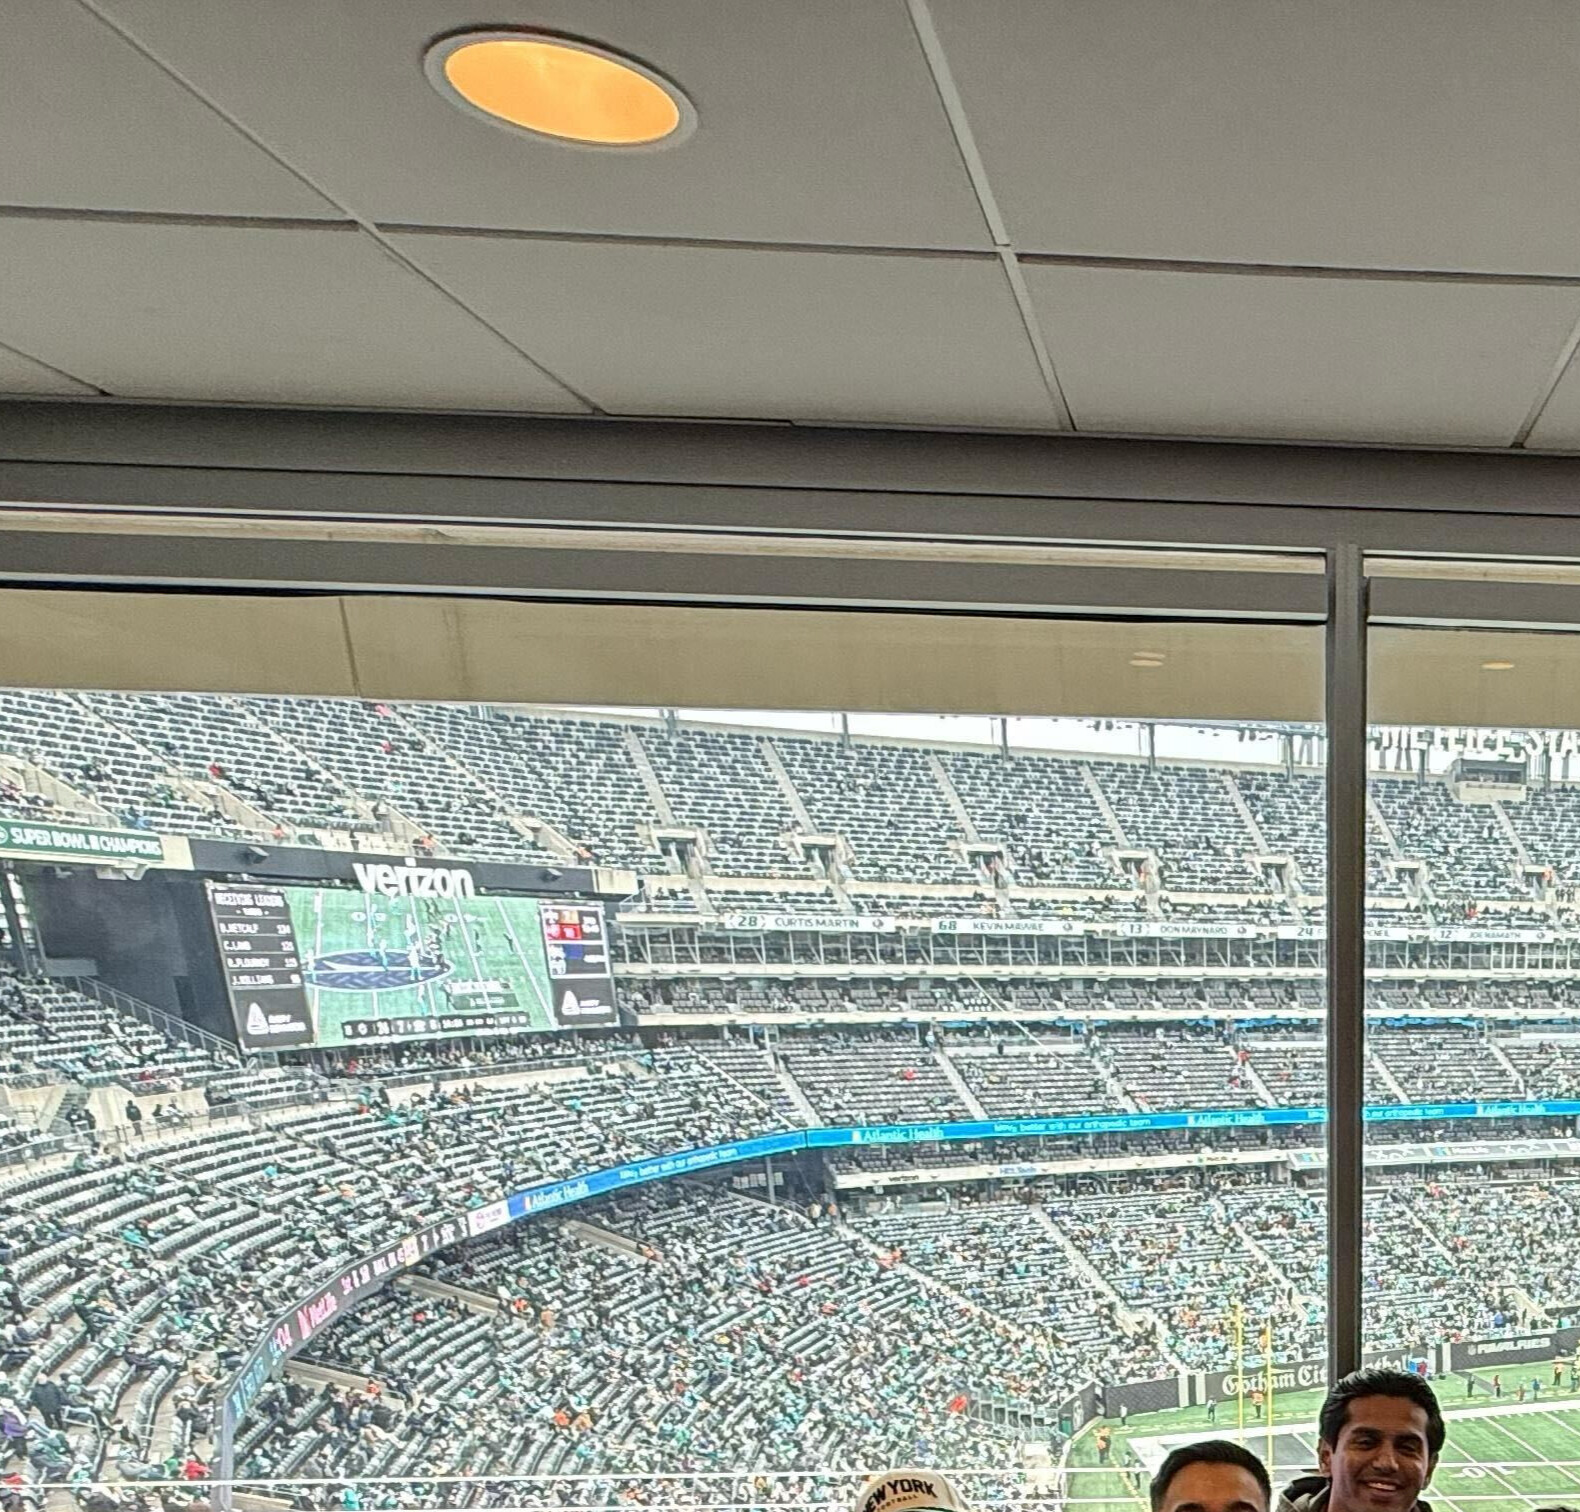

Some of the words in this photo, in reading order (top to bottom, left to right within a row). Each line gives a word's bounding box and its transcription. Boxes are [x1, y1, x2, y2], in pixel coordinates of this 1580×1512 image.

[11, 827, 51, 847] SUPER
[53, 831, 88, 849] BOWL
[100, 836, 162, 856] CHAMPIONS
[352, 859, 475, 897] verizon
[737, 916, 758, 927] 28
[775, 918, 813, 928] CURTIS
[815, 918, 860, 928] MARTIN
[938, 920, 958, 931] 68
[1128, 924, 1143, 935] 13
[1160, 926, 1180, 935] DON
[1182, 926, 1228, 935] MAYNARD
[1440, 930, 1453, 939] 12
[1199, 1113, 1233, 1126] Atlantic
[863, 1129, 908, 1142] Atlantic
[909, 1128, 945, 1140] Health
[532, 1188, 564, 1209] Atlantic
[1222, 1369, 1297, 1396] Gotham
[1297, 1363, 1328, 1386] Cit
[887, 1478, 938, 1499] YORK
[876, 1494, 919, 1512] FOOTBALL
